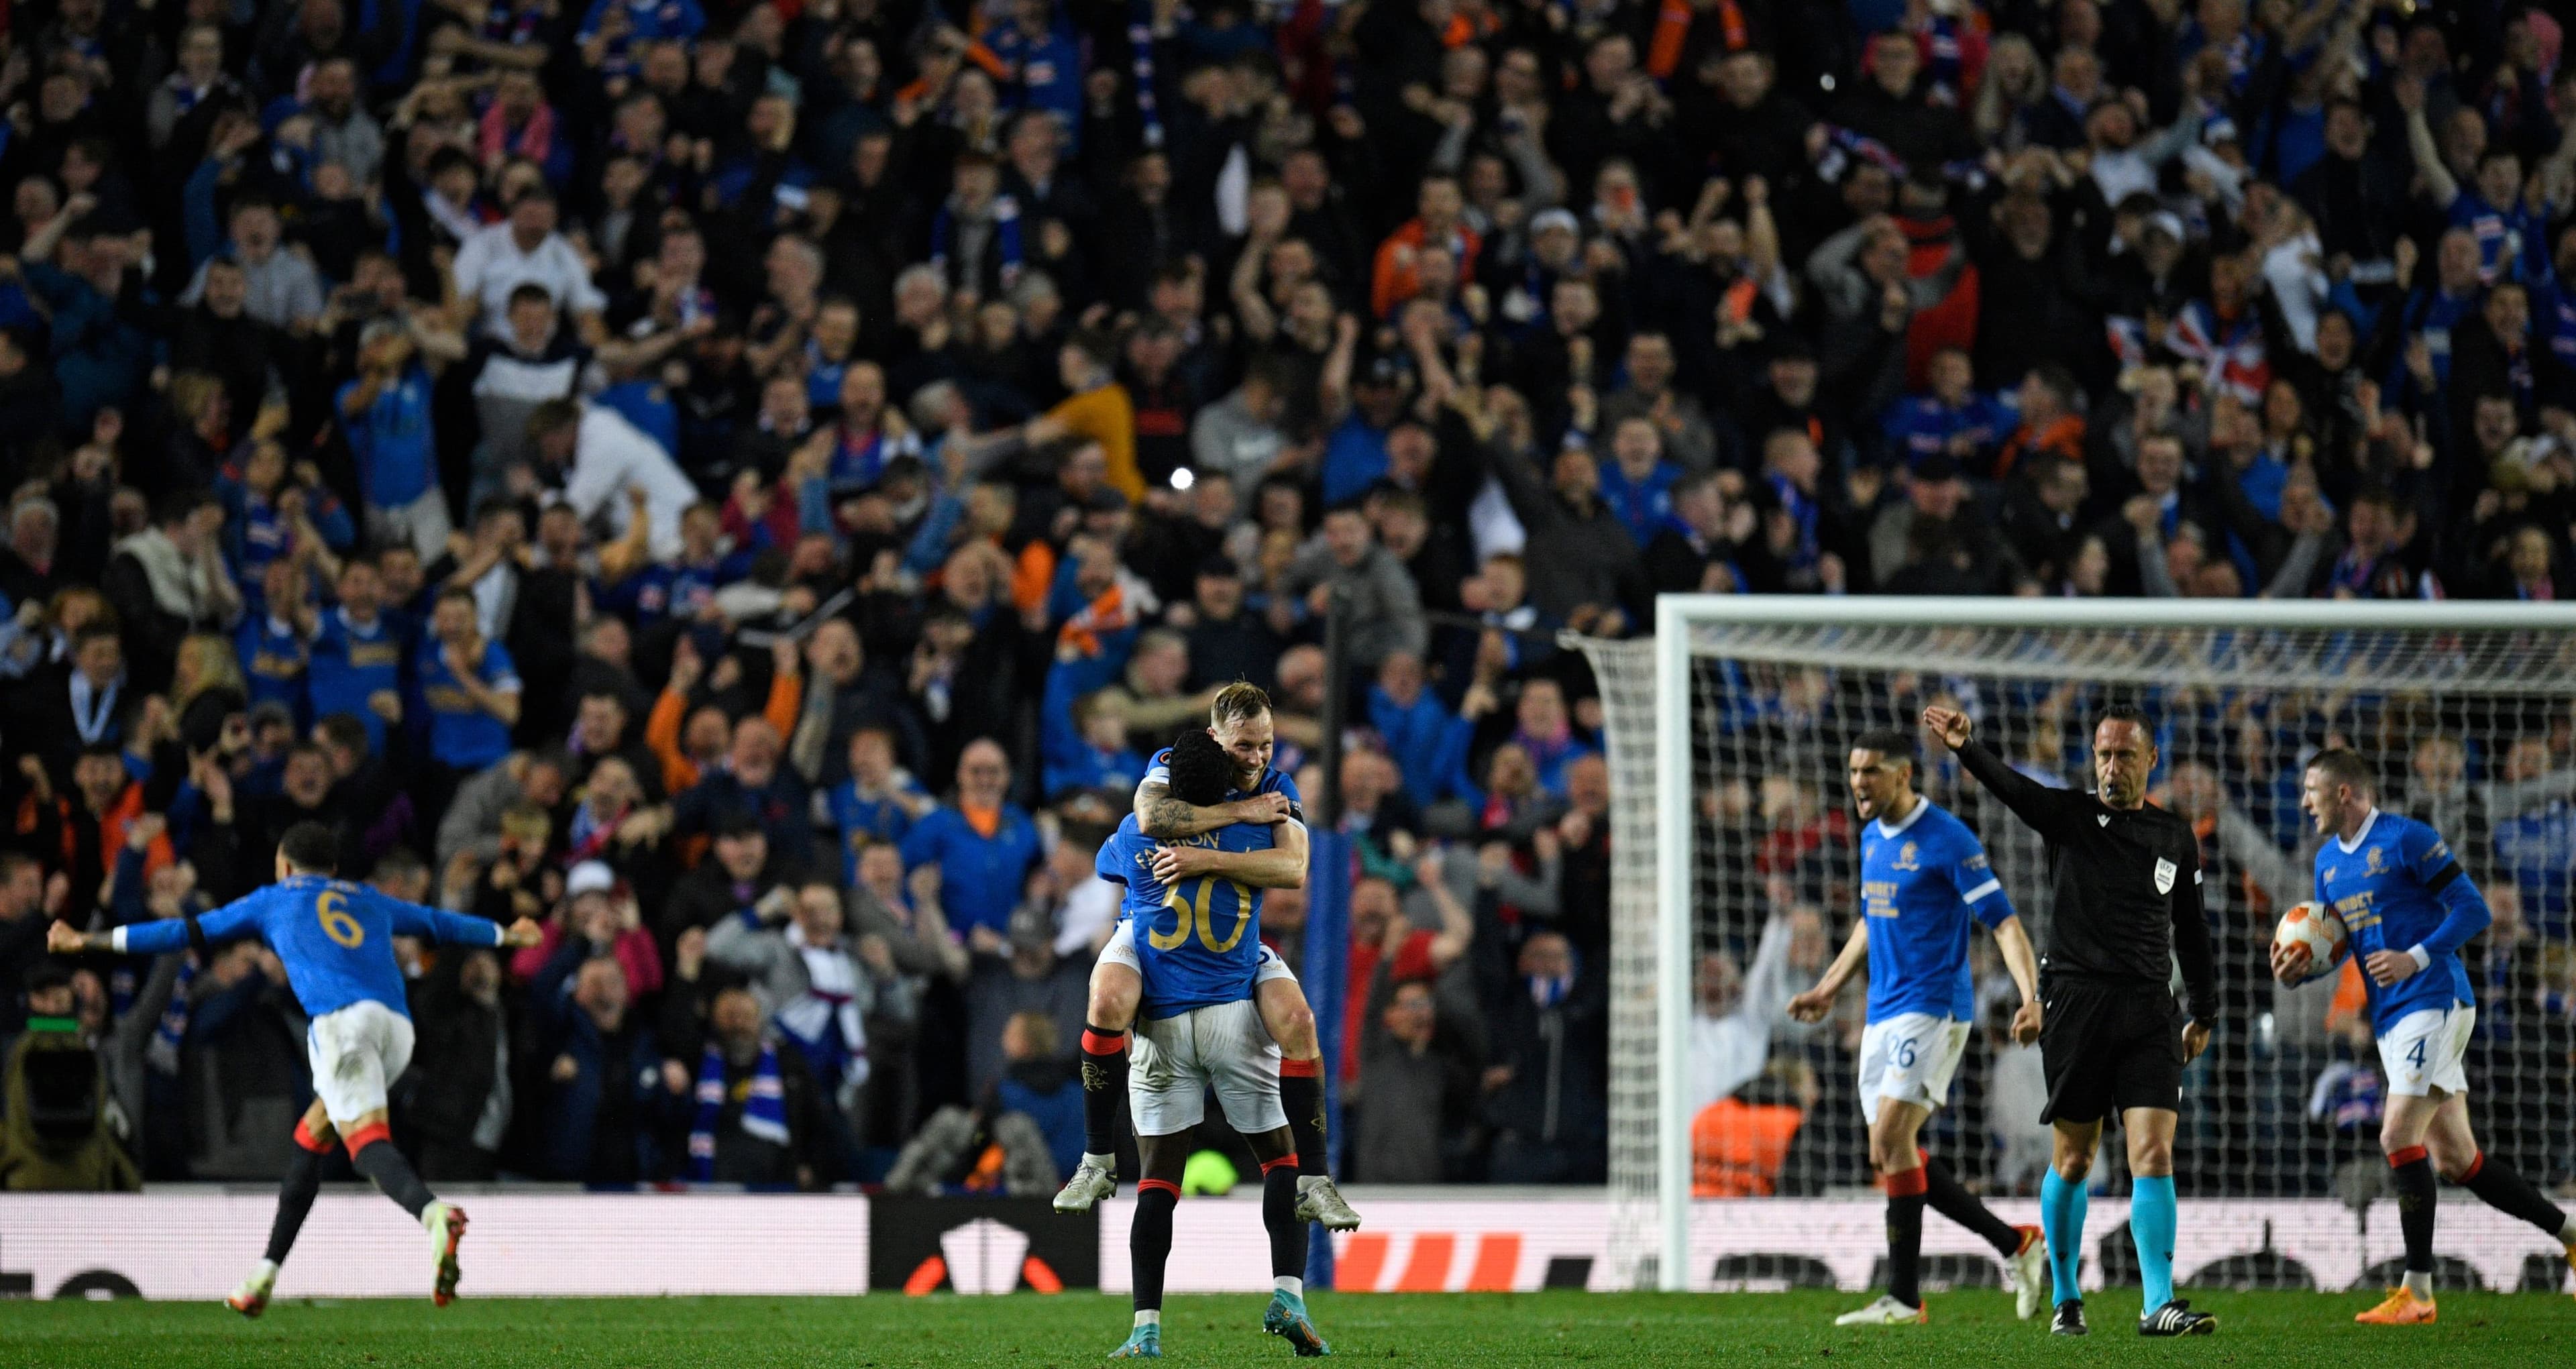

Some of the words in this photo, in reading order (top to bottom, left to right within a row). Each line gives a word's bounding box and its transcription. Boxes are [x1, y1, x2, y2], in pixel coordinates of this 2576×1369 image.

[317, 891, 363, 948] 6
[1887, 1034, 1917, 1068] 26
[2406, 1038, 2426, 1069] 4
